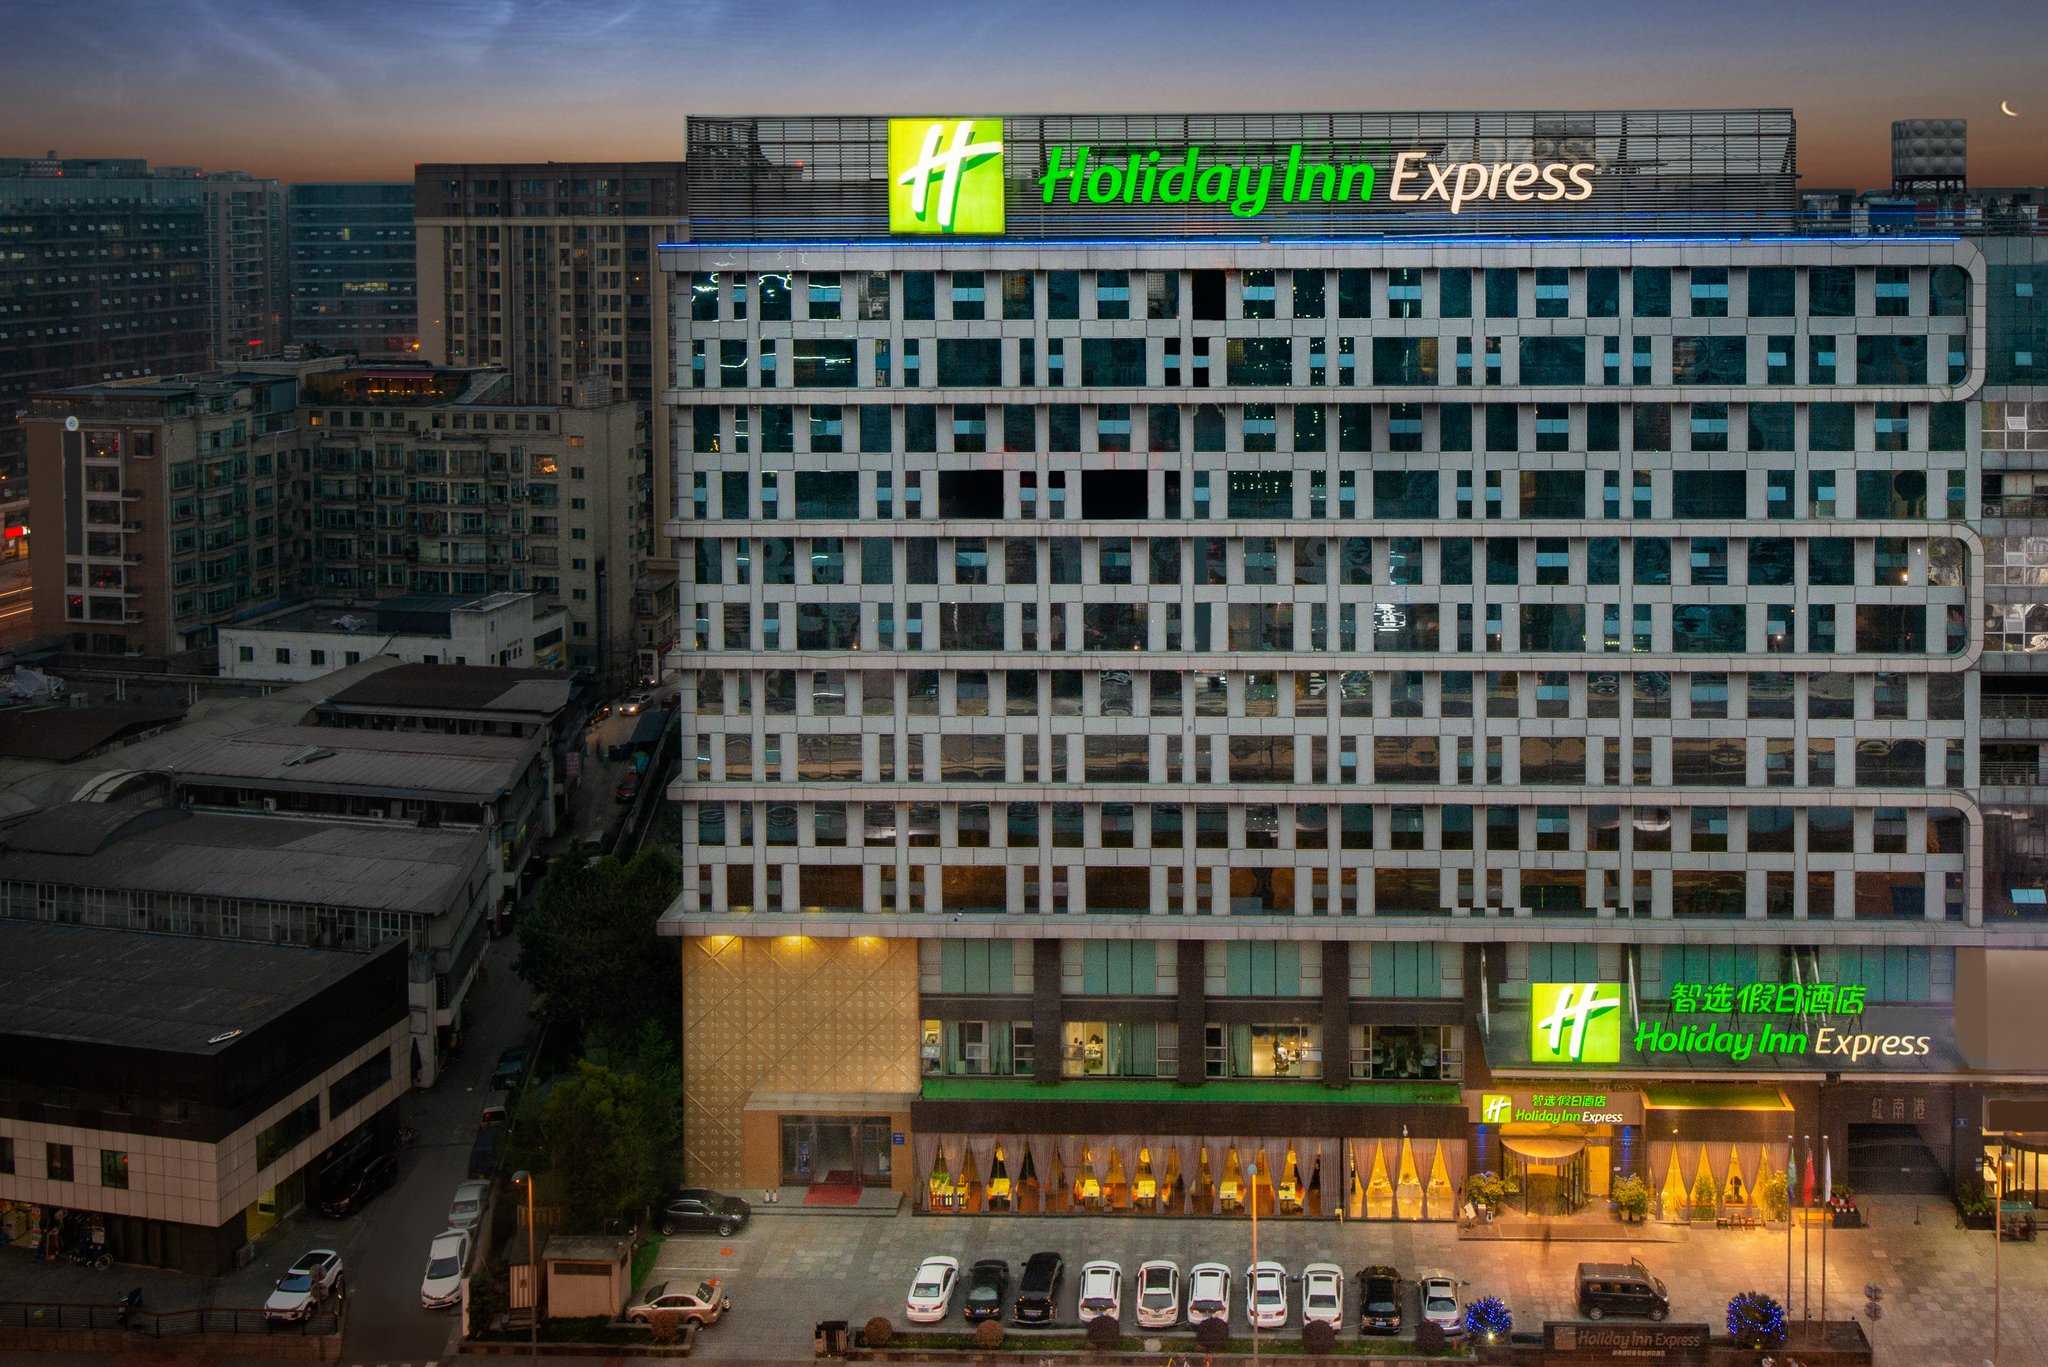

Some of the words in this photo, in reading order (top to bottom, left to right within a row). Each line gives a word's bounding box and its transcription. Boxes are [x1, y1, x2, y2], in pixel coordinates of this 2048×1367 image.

[1038, 145, 1274, 217] Holiday
[1281, 144, 1375, 203] Inn
[1389, 152, 1596, 214] Express
[1669, 983, 1867, 1015] 智选假日酒店
[1632, 1021, 1755, 1061] Holiday
[1757, 1022, 1810, 1055] Inn
[1815, 1027, 1932, 1062] Express
[1532, 1094, 1607, 1108] 智选假日酒店
[1516, 1109, 1562, 1124] Holiday
[1562, 1109, 1581, 1121] Inn
[1582, 1111, 1624, 1125] Express
[1577, 1330, 1629, 1348] Holiday
[1631, 1330, 1654, 1347] Inn
[1655, 1333, 1701, 1349] Express
